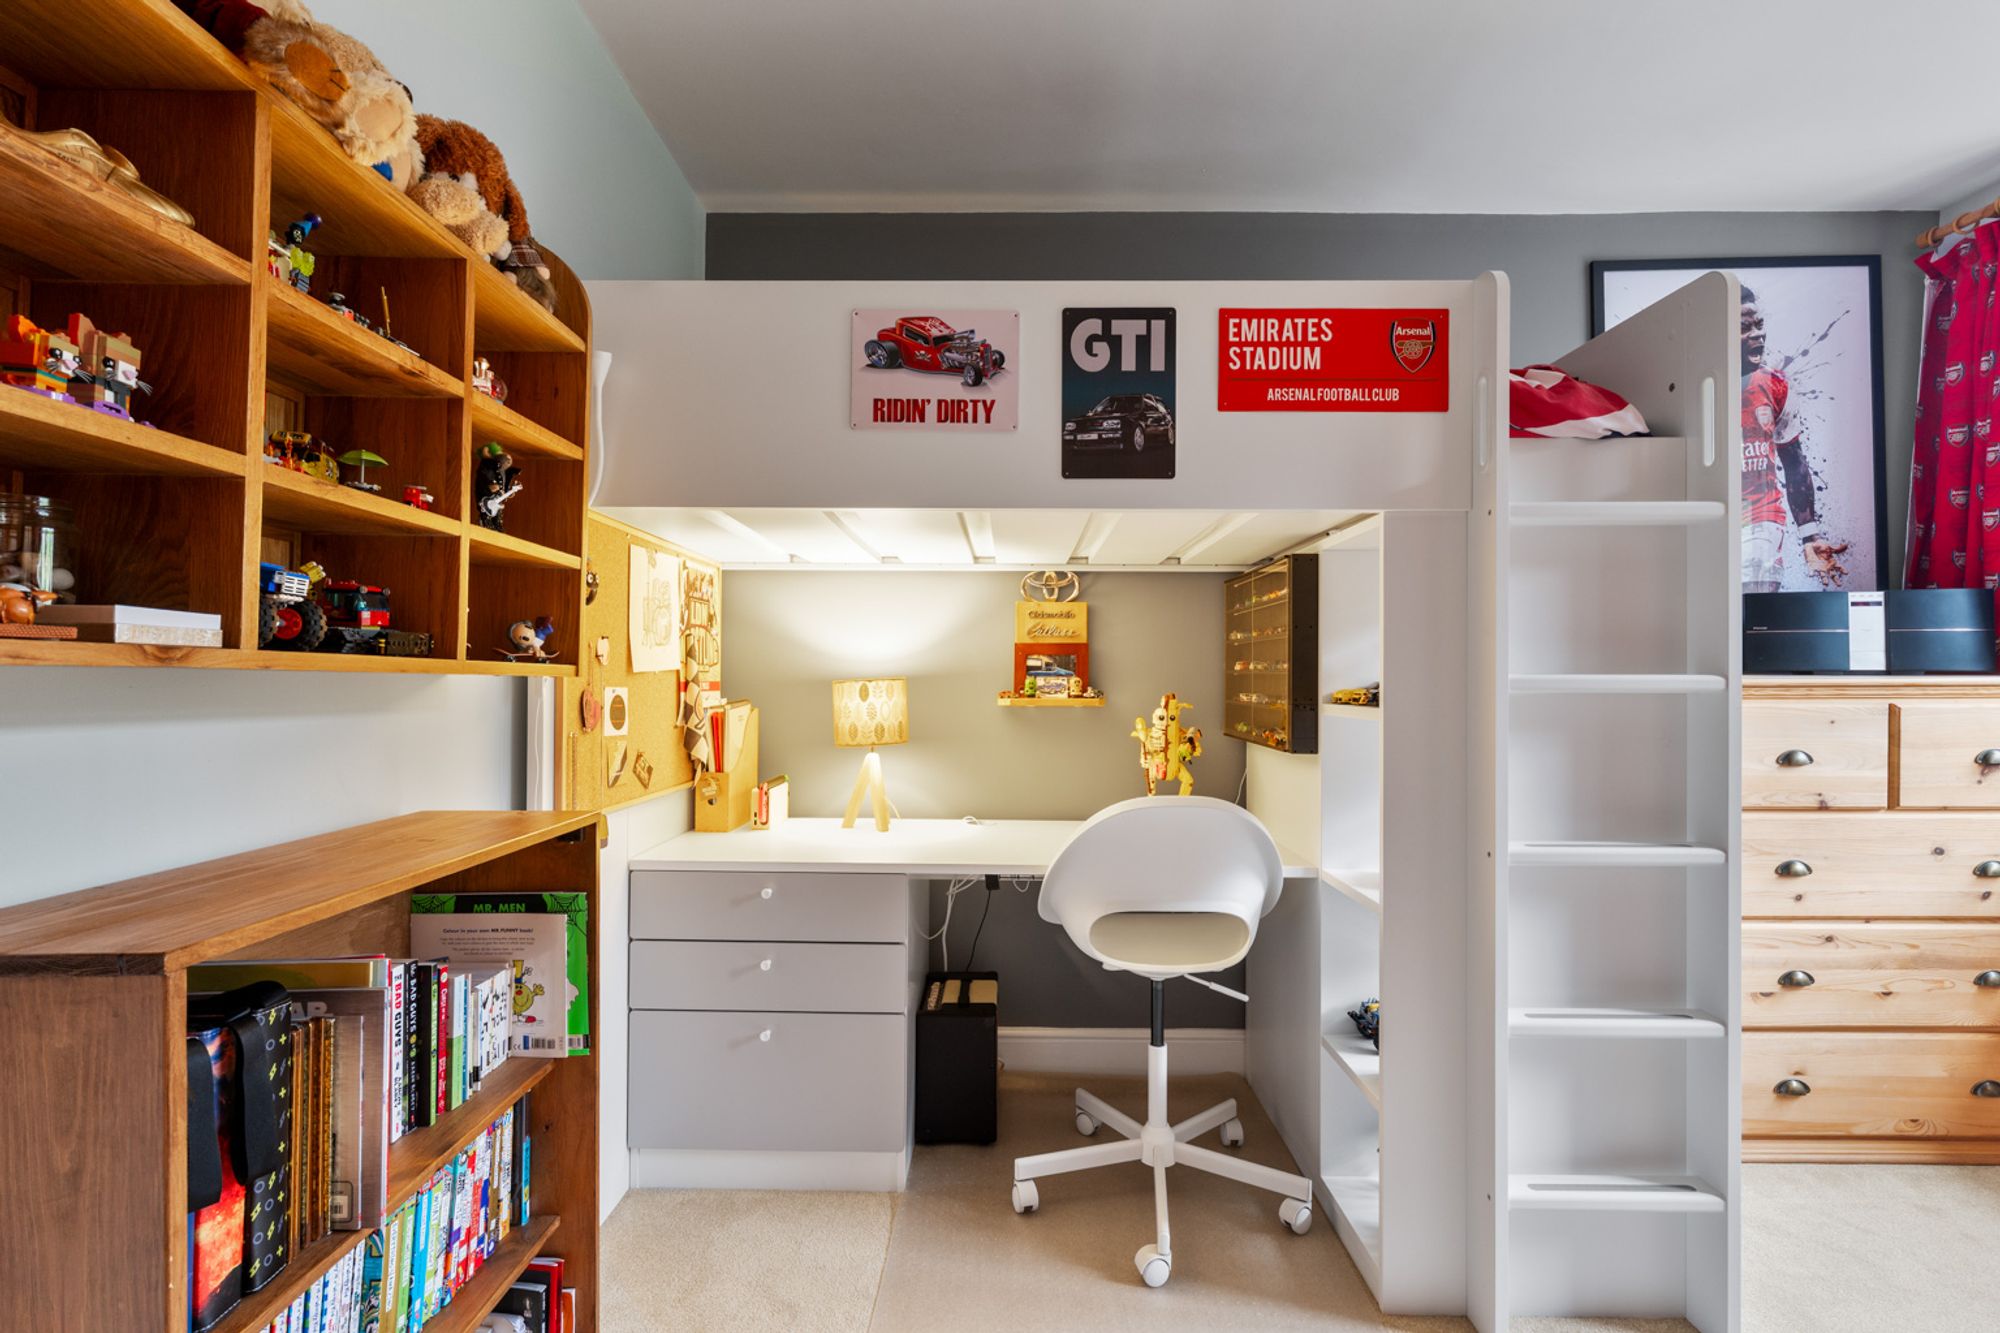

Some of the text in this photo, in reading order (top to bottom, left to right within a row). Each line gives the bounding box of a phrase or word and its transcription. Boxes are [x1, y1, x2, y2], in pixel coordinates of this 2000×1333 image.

[1228, 318, 1333, 342] EMIRATES
[1395, 326, 1430, 336] Arsenal
[1070, 318, 1166, 373] GTI
[1228, 346, 1321, 371] STADIUM
[1267, 388, 1400, 401] ARSENAL FOOTBALL CLUB
[872, 398, 996, 424] RIDIN' DIRTY
[1742, 458, 1768, 472] ETTER
[473, 903, 526, 913] MR. MEN
[394, 982, 402, 1010] BAD
[409, 979, 417, 1002] BAD
[394, 1011, 402, 1048] GUYS
[409, 1002, 417, 1033] GUYS
